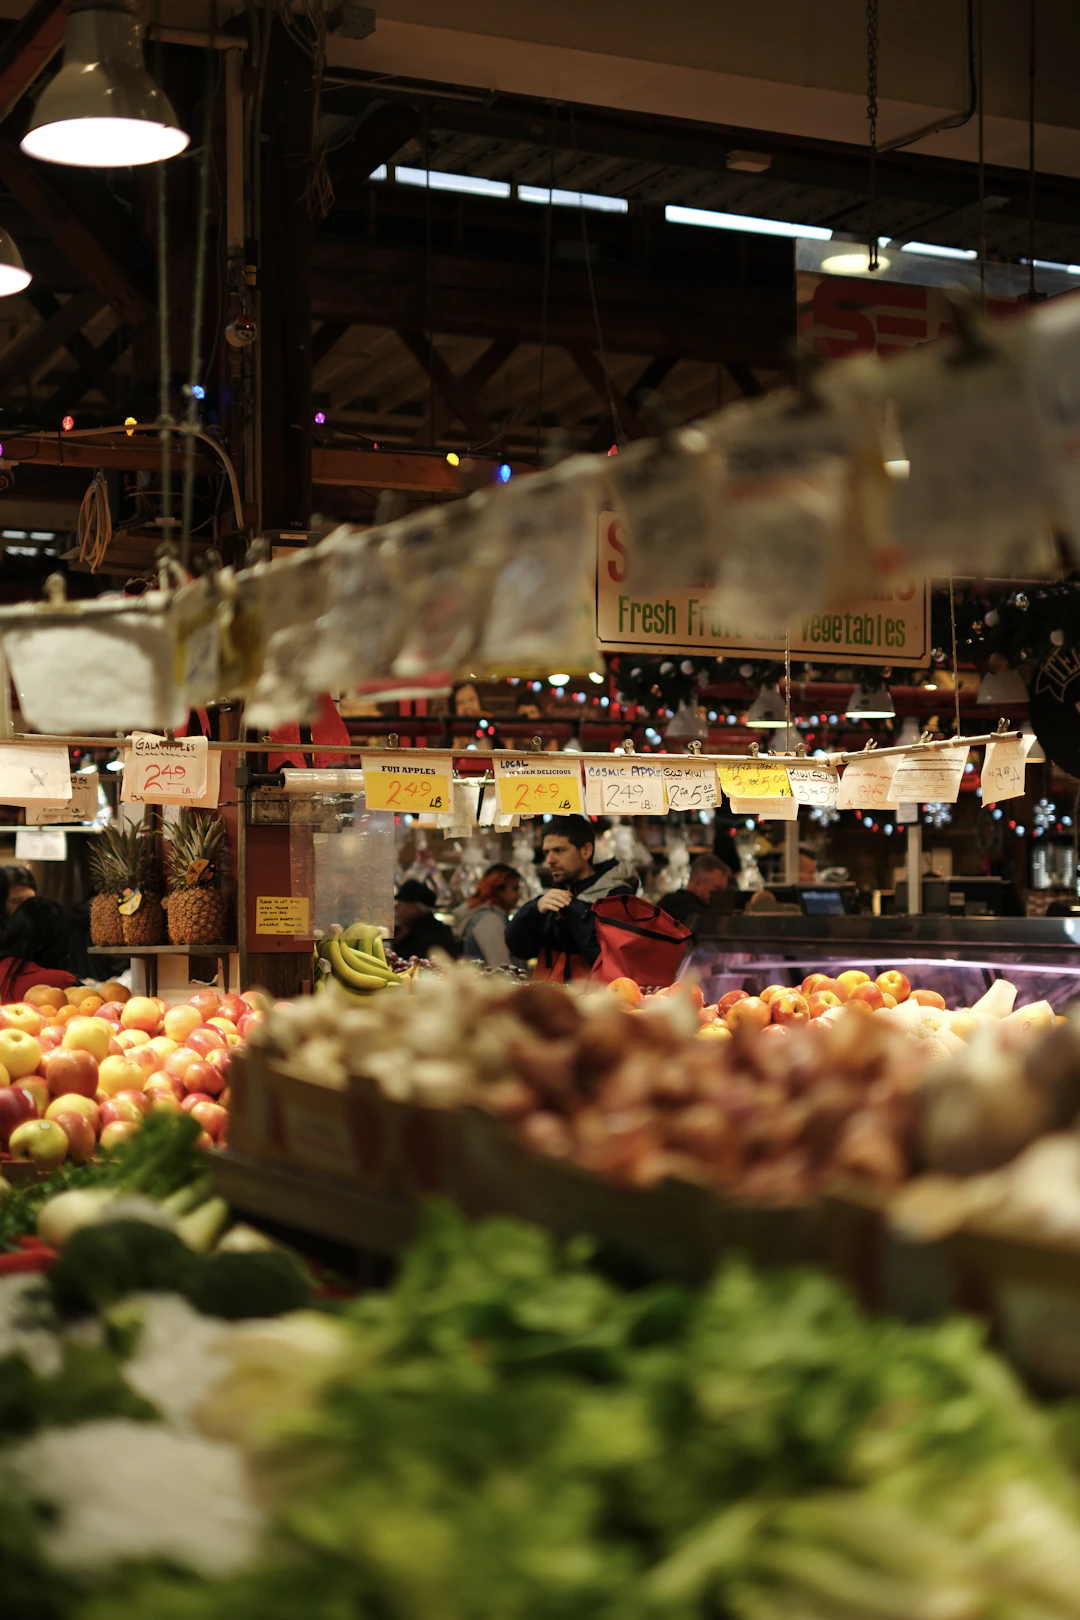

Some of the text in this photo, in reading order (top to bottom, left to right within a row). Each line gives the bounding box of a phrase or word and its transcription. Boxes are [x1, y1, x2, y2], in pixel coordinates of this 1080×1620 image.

[618, 594, 677, 634] Fresh
[800, 606, 906, 648] Vegetables
[500, 759, 529, 769] LOCAL
[381, 765, 436, 775] FUJI APPLES
[588, 766, 626, 777] COSMIC
[663, 767, 706, 778] GOLD KIWI
[732, 775, 746, 795] 3
[668, 785, 680, 807] 2
[799, 786, 810, 801] 3
[429, 796, 443, 808] LB
[558, 799, 571, 809] LB
